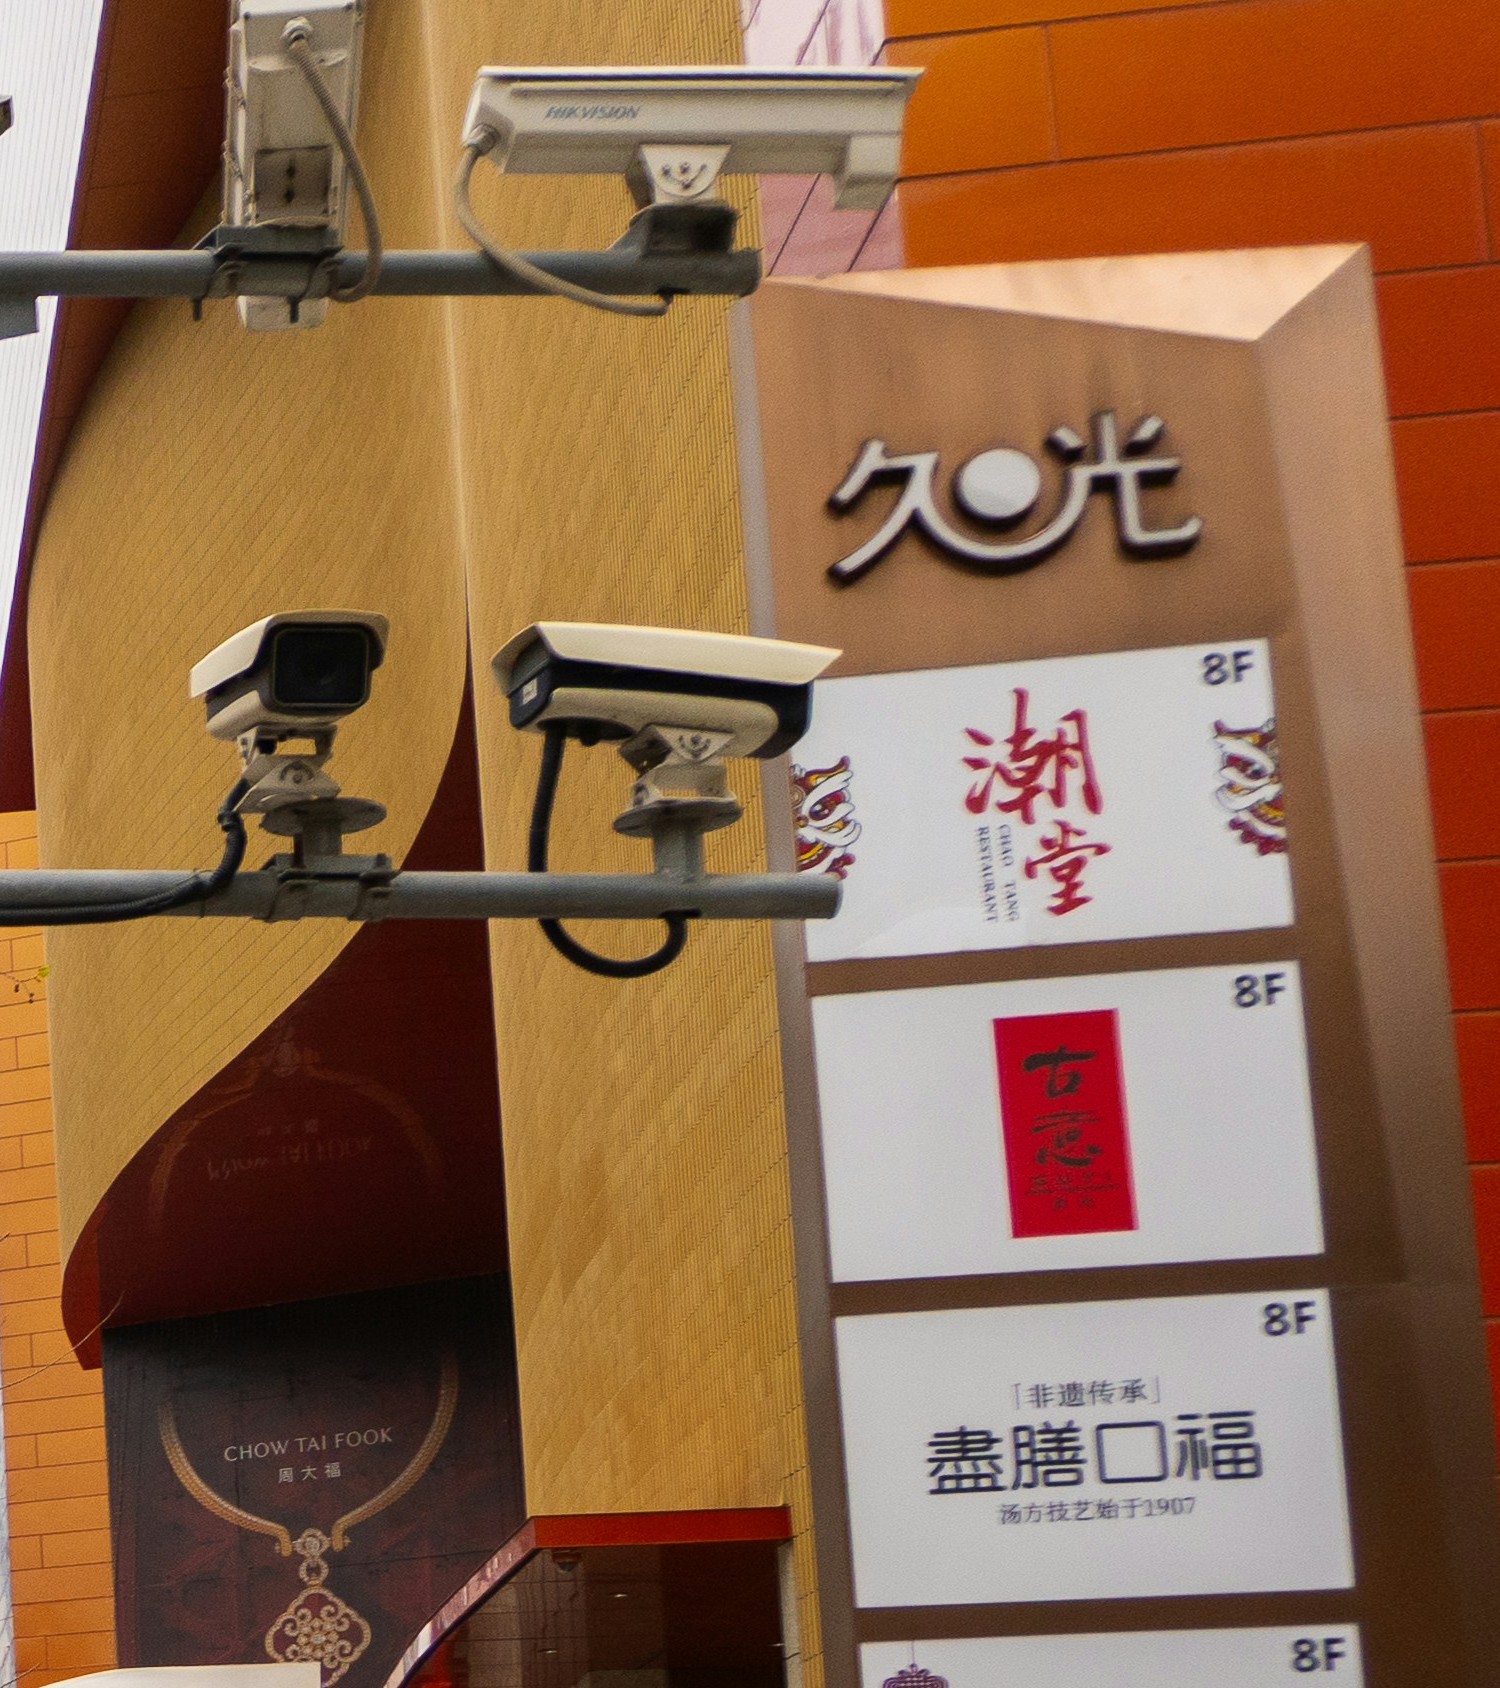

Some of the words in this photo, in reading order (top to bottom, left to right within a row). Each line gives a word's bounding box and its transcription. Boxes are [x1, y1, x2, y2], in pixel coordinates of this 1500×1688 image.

[544, 104, 641, 120] HIKVISION
[825, 408, 1204, 586] 久光
[1202, 650, 1256, 687] 8F
[961, 687, 1112, 917] 潮堂
[996, 825, 1015, 868] CHAO
[975, 826, 1000, 925] RESTAURANT
[1003, 880, 1021, 923] TANG
[1233, 971, 1287, 1009] 8F
[1022, 1045, 1106, 1170] 古意
[1262, 1301, 1317, 1337] 8F
[223, 1437, 291, 1463] CHOW
[294, 1435, 327, 1454] TAI
[333, 1426, 394, 1449] FOOK
[278, 1462, 342, 1484] 周大福
[997, 1494, 1198, 1527] 汤方技艺始于1907
[1291, 1636, 1347, 1674] 8F
